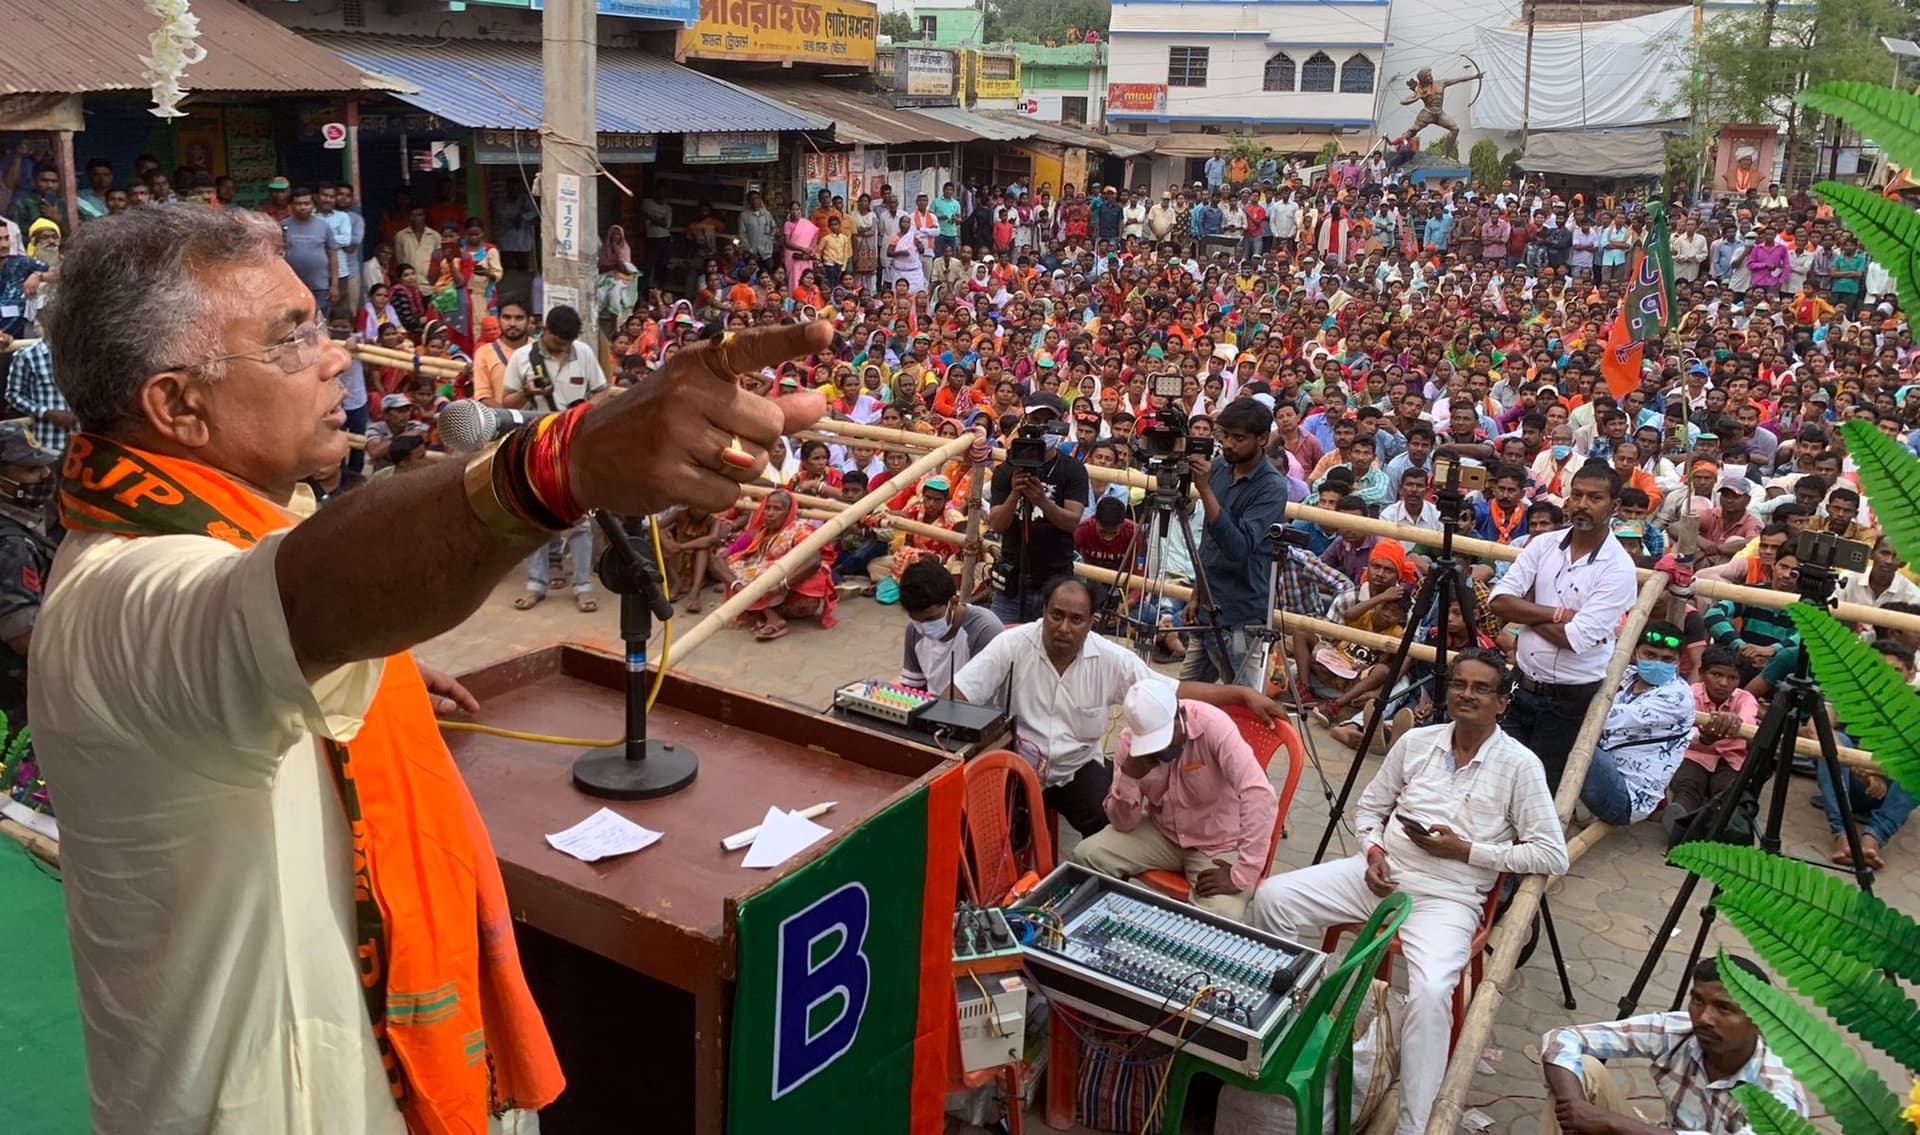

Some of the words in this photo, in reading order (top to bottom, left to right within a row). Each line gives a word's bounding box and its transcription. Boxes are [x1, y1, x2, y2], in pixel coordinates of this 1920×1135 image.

[562, 205, 574, 251] 1276
[63, 433, 185, 509] BJP
[771, 880, 871, 1101] B
